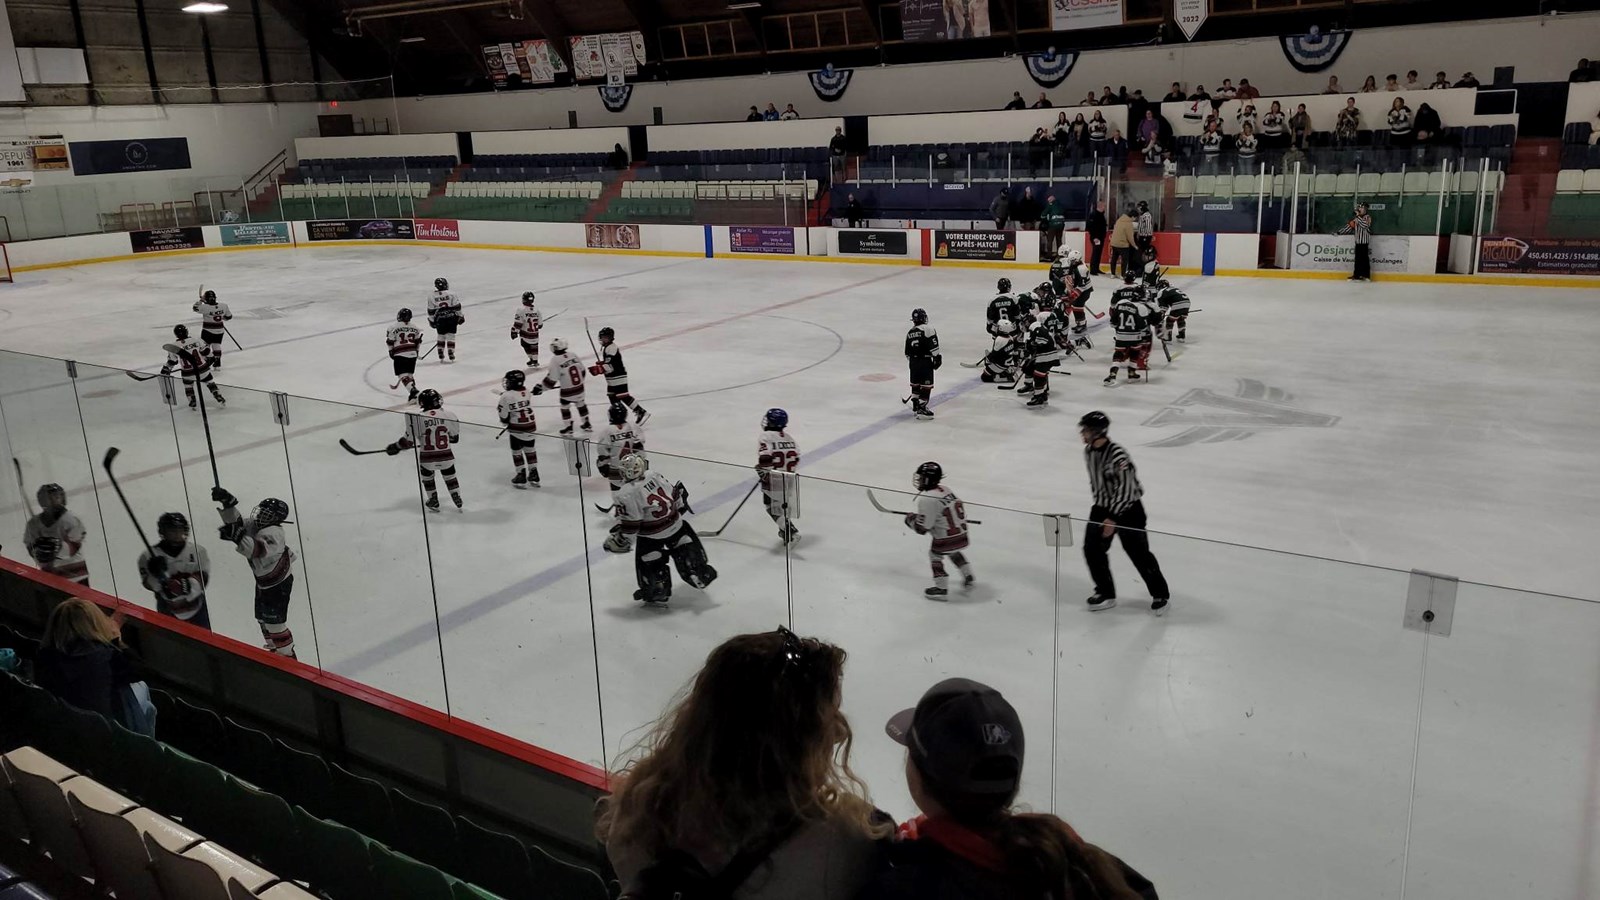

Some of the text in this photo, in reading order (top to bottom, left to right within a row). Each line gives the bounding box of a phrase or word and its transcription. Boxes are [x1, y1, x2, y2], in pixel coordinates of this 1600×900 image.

[1182, 15, 1200, 23] 2022
[1190, 101, 1199, 113] 4
[416, 223, 458, 237] Tim Hortons
[945, 232, 1005, 241] VOTRE RENDEZ-VOUS
[950, 239, 1000, 249] D'APRÈS-MATCH!
[1482, 246, 1523, 261] RIGAUD
[1118, 312, 1136, 330] 14
[423, 425, 449, 451] 16
